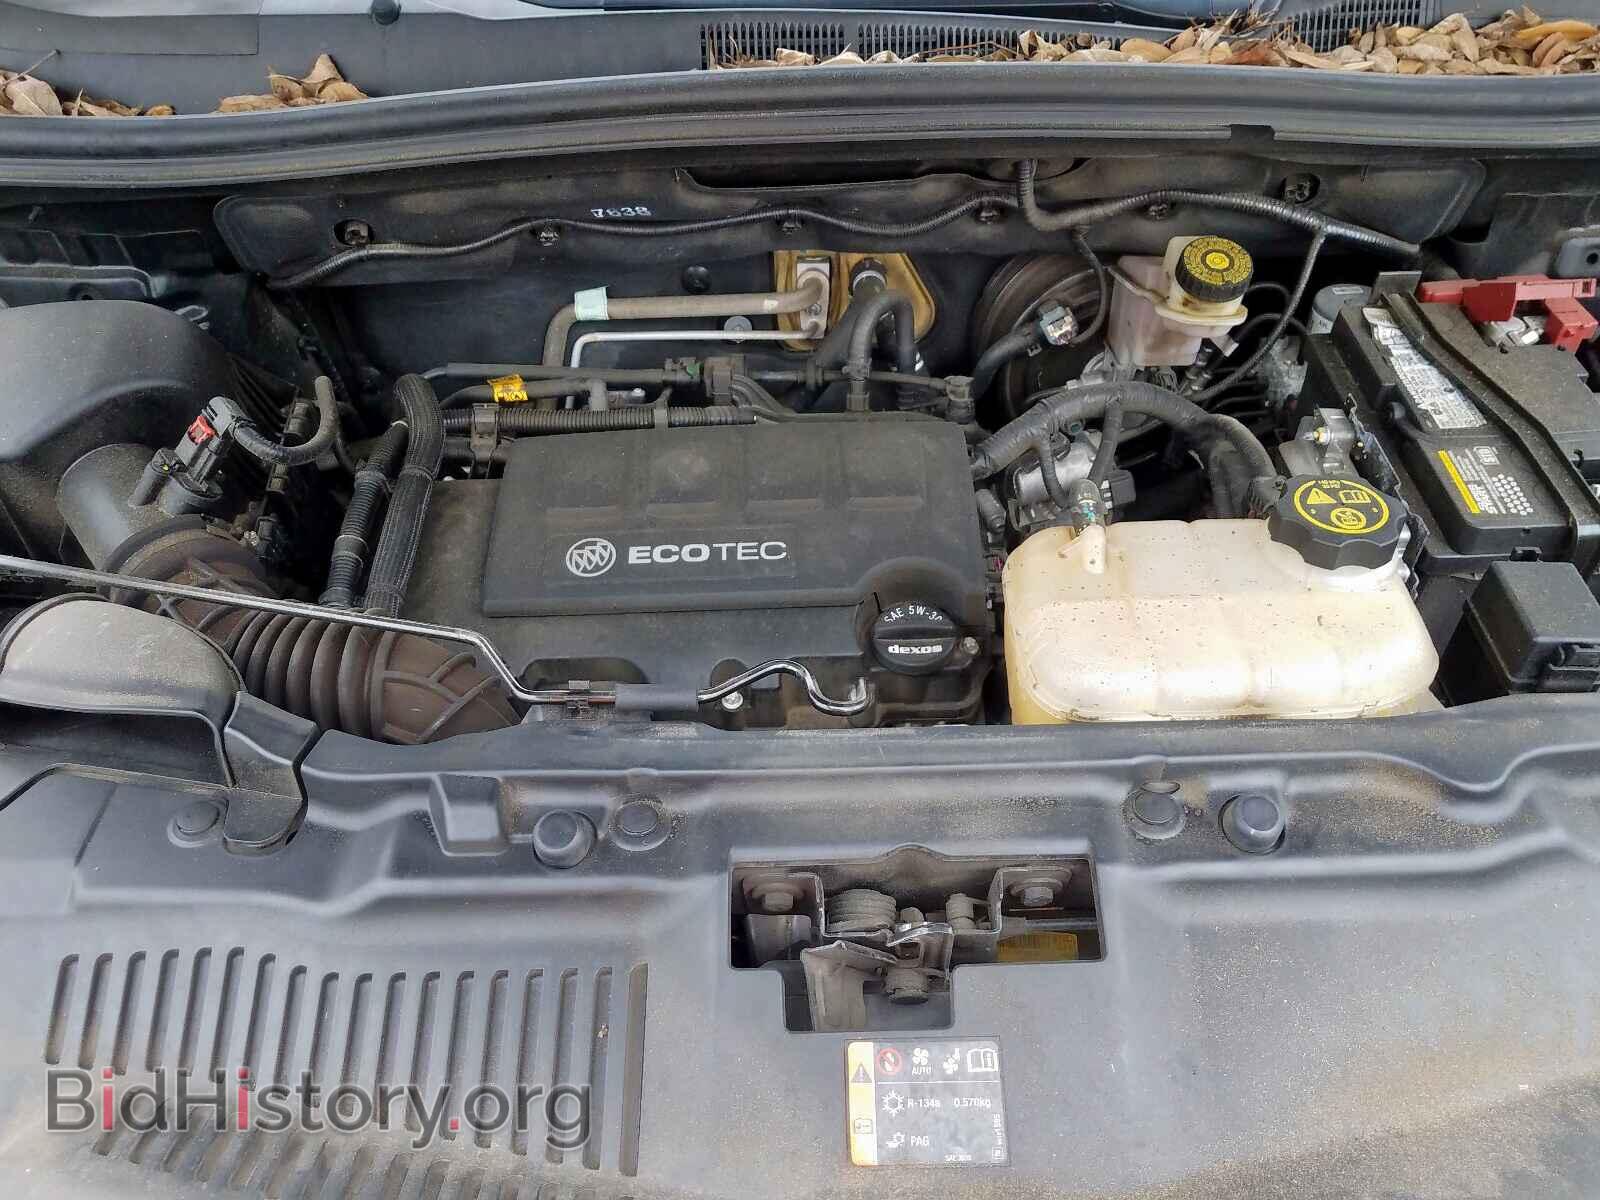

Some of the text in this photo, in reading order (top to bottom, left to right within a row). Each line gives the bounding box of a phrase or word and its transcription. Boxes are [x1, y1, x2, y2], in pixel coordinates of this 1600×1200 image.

[628, 541, 787, 564] ECOTEC
[884, 607, 904, 622] SAE
[887, 644, 943, 654] dexos
[911, 1066, 932, 1076] AUTO
[910, 1135, 929, 1147] PAG
